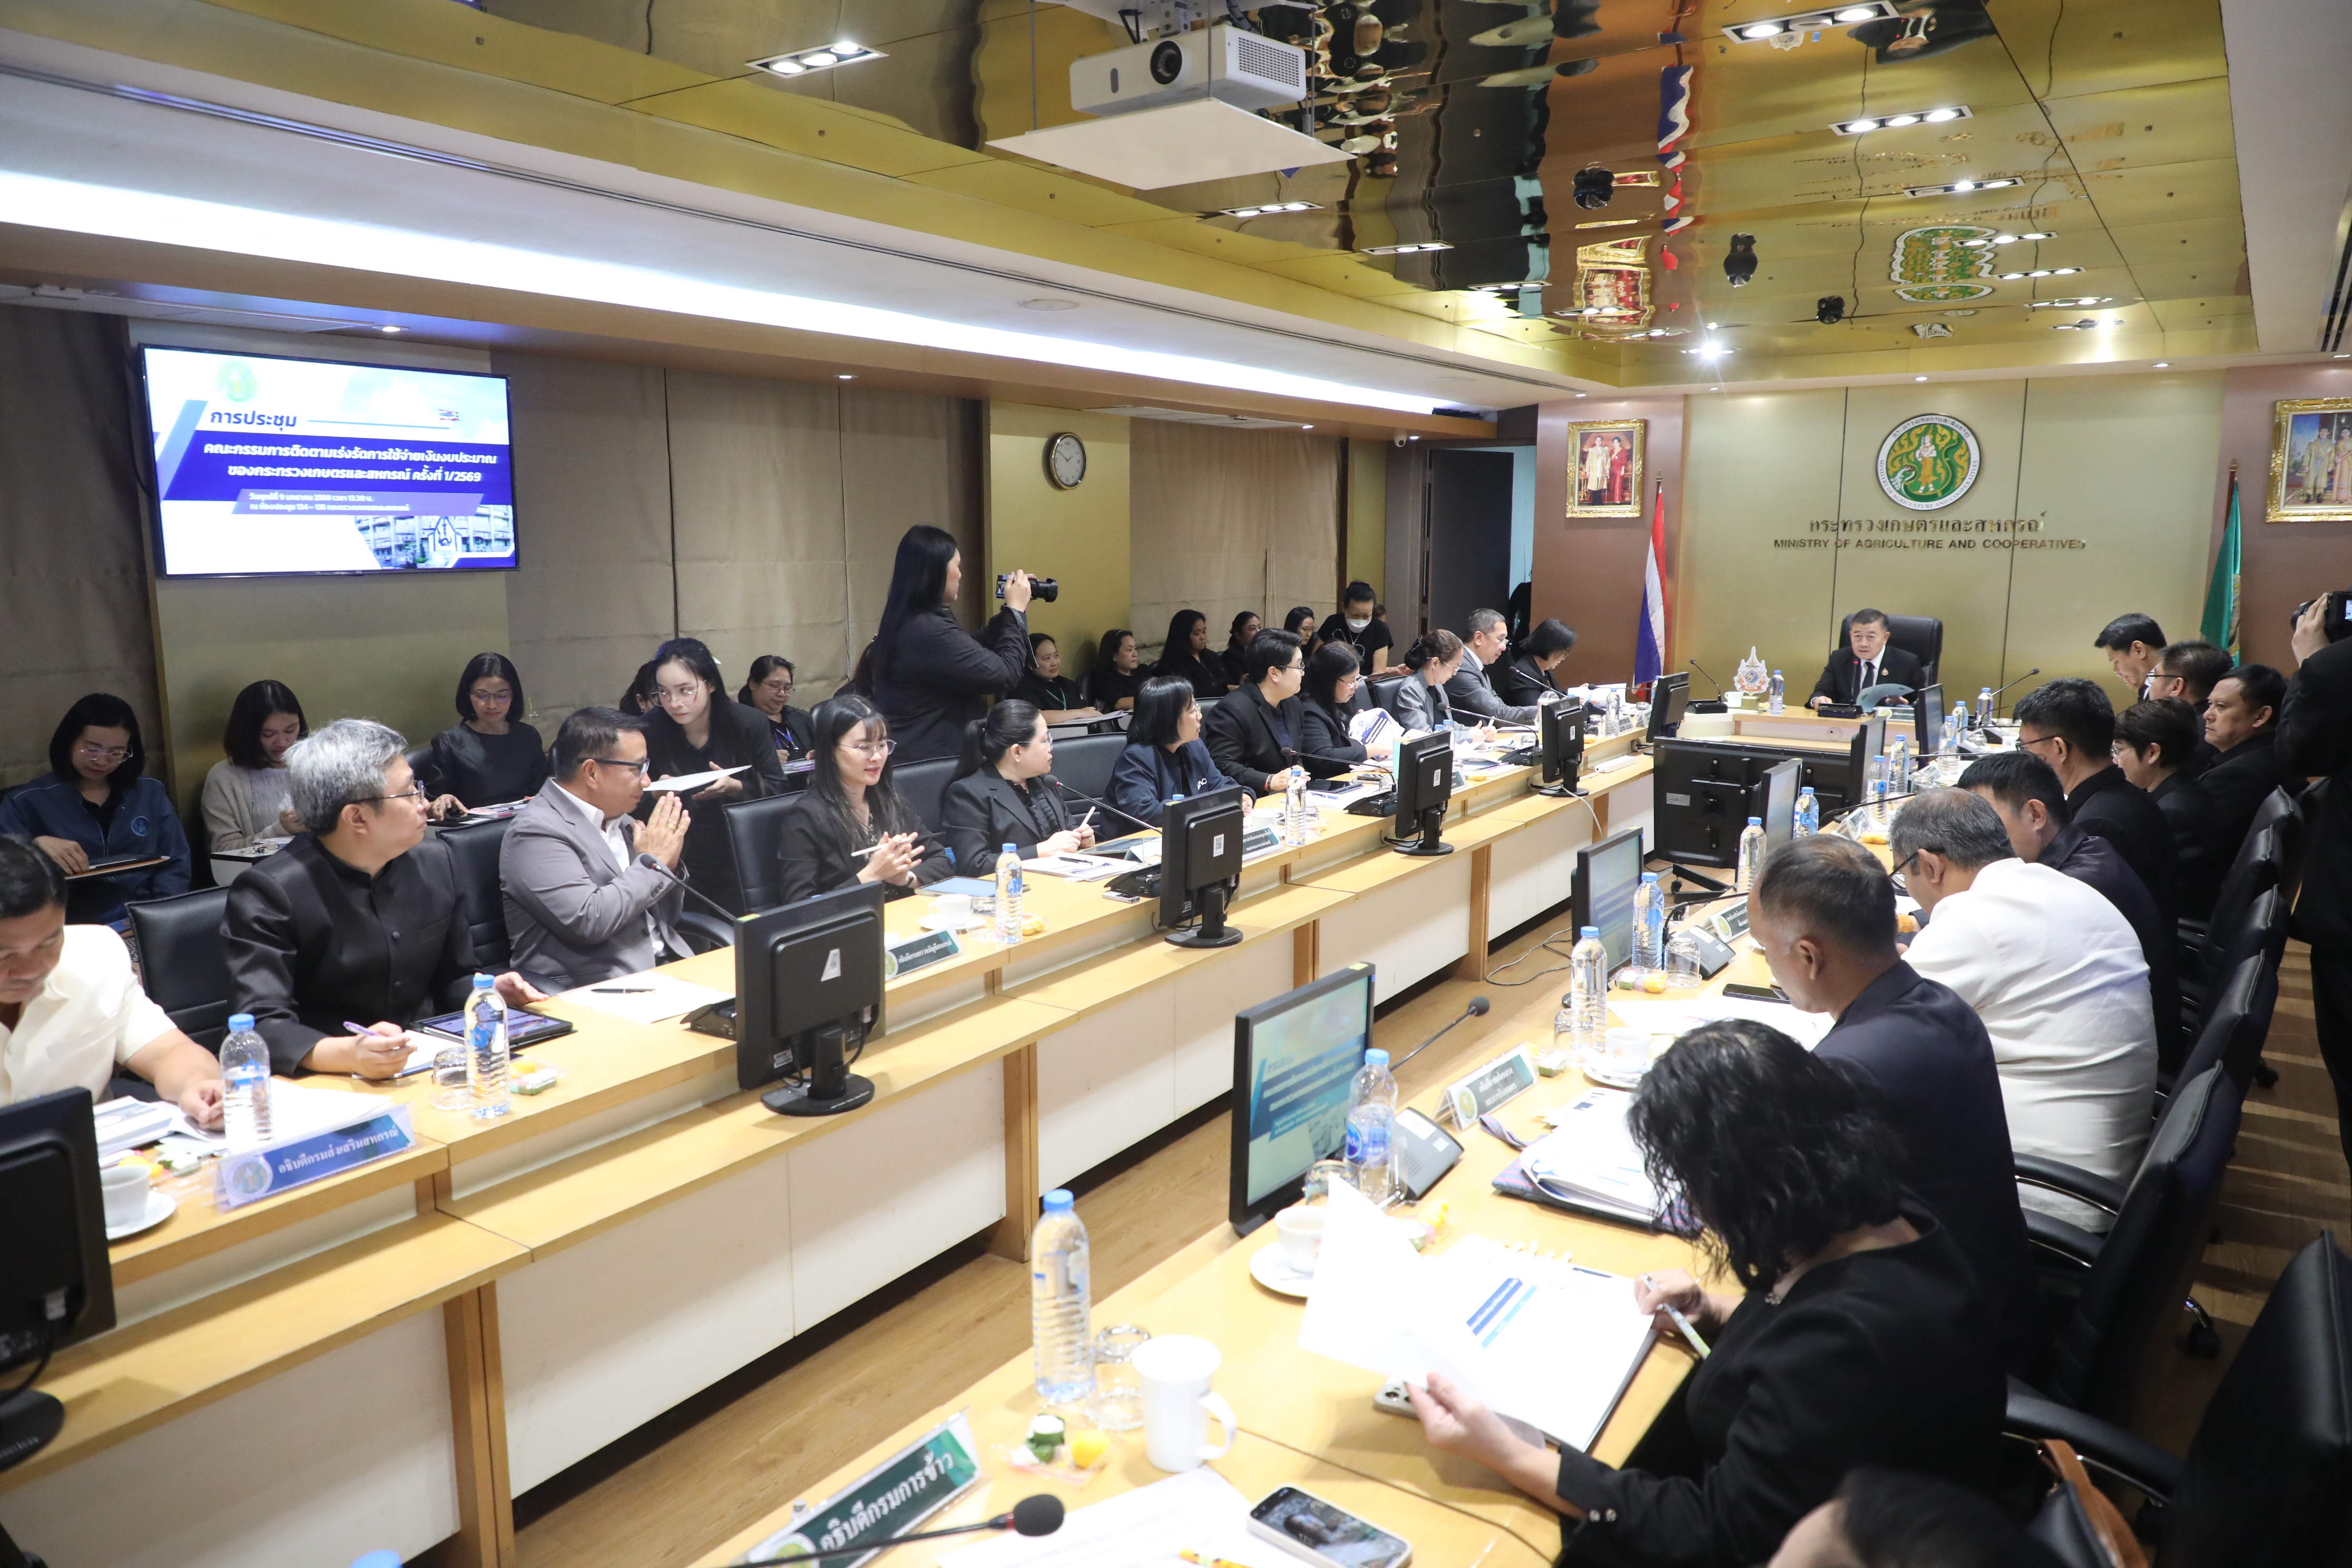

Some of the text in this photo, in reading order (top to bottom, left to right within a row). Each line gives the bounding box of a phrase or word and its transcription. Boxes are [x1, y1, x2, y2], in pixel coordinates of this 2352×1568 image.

[211, 410, 297, 432] การประชุม
[204, 444, 497, 464] คณะกรรมการติดตามเร่งรัดการใช้จ่ายเงินงบประมาณ
[228, 465, 482, 482] ของกระทรวงเกษตรและสหกรณ์ ครั้งที่ 1/2569
[1893, 494, 1934, 508] AGRICULTURE
[1935, 498, 1949, 508] AND
[1810, 511, 2046, 532] กระทรวงเกษตรและสหกรณ์
[1774, 539, 2086, 549] MINISTRY OF AGRICULTURE AND COOPERATIVES
[278, 1123, 399, 1174] อธิบดีกรมส่งเสริมสหกรณ์
[819, 1450, 954, 1551] อธิบดีกรมการข้าว
